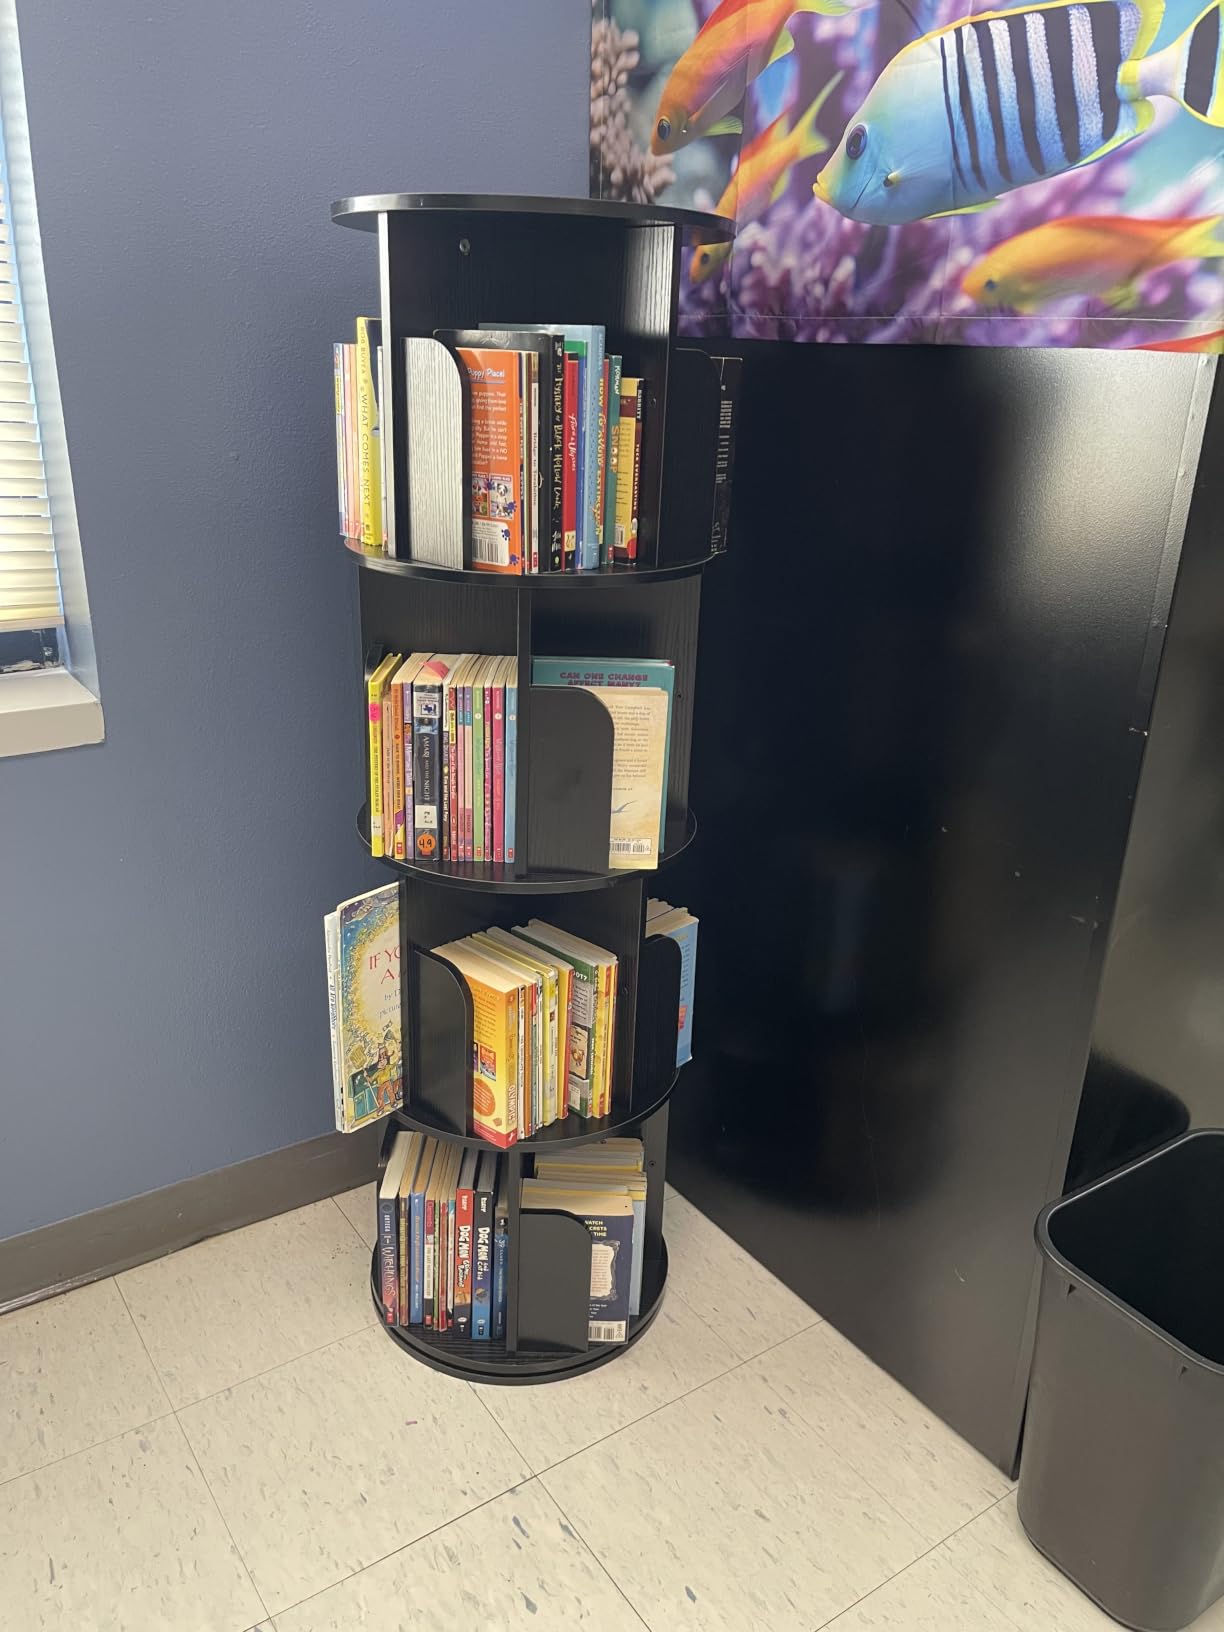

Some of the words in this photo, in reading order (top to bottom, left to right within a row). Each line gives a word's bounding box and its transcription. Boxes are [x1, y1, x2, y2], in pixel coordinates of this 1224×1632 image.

[553, 377, 563, 413] MYSTERY
[361, 393, 370, 427] WHAT
[361, 433, 371, 473] COMES
[610, 425, 622, 473] SNOOP
[363, 479, 371, 507] NEXT
[559, 671, 580, 679] CAN
[583, 672, 605, 680] ONE
[607, 673, 648, 682] CHANGE
[422, 735, 430, 758] AMARI
[423, 779, 431, 801] NIGHT
[419, 838, 432, 849] 4.9
[369, 952, 381, 970] IF
[380, 968, 396, 985] A
[459, 1225, 471, 1242] DOG
[477, 1227, 490, 1244] DOG
[458, 1242, 470, 1259] MAN
[477, 1244, 489, 1261] MAN
